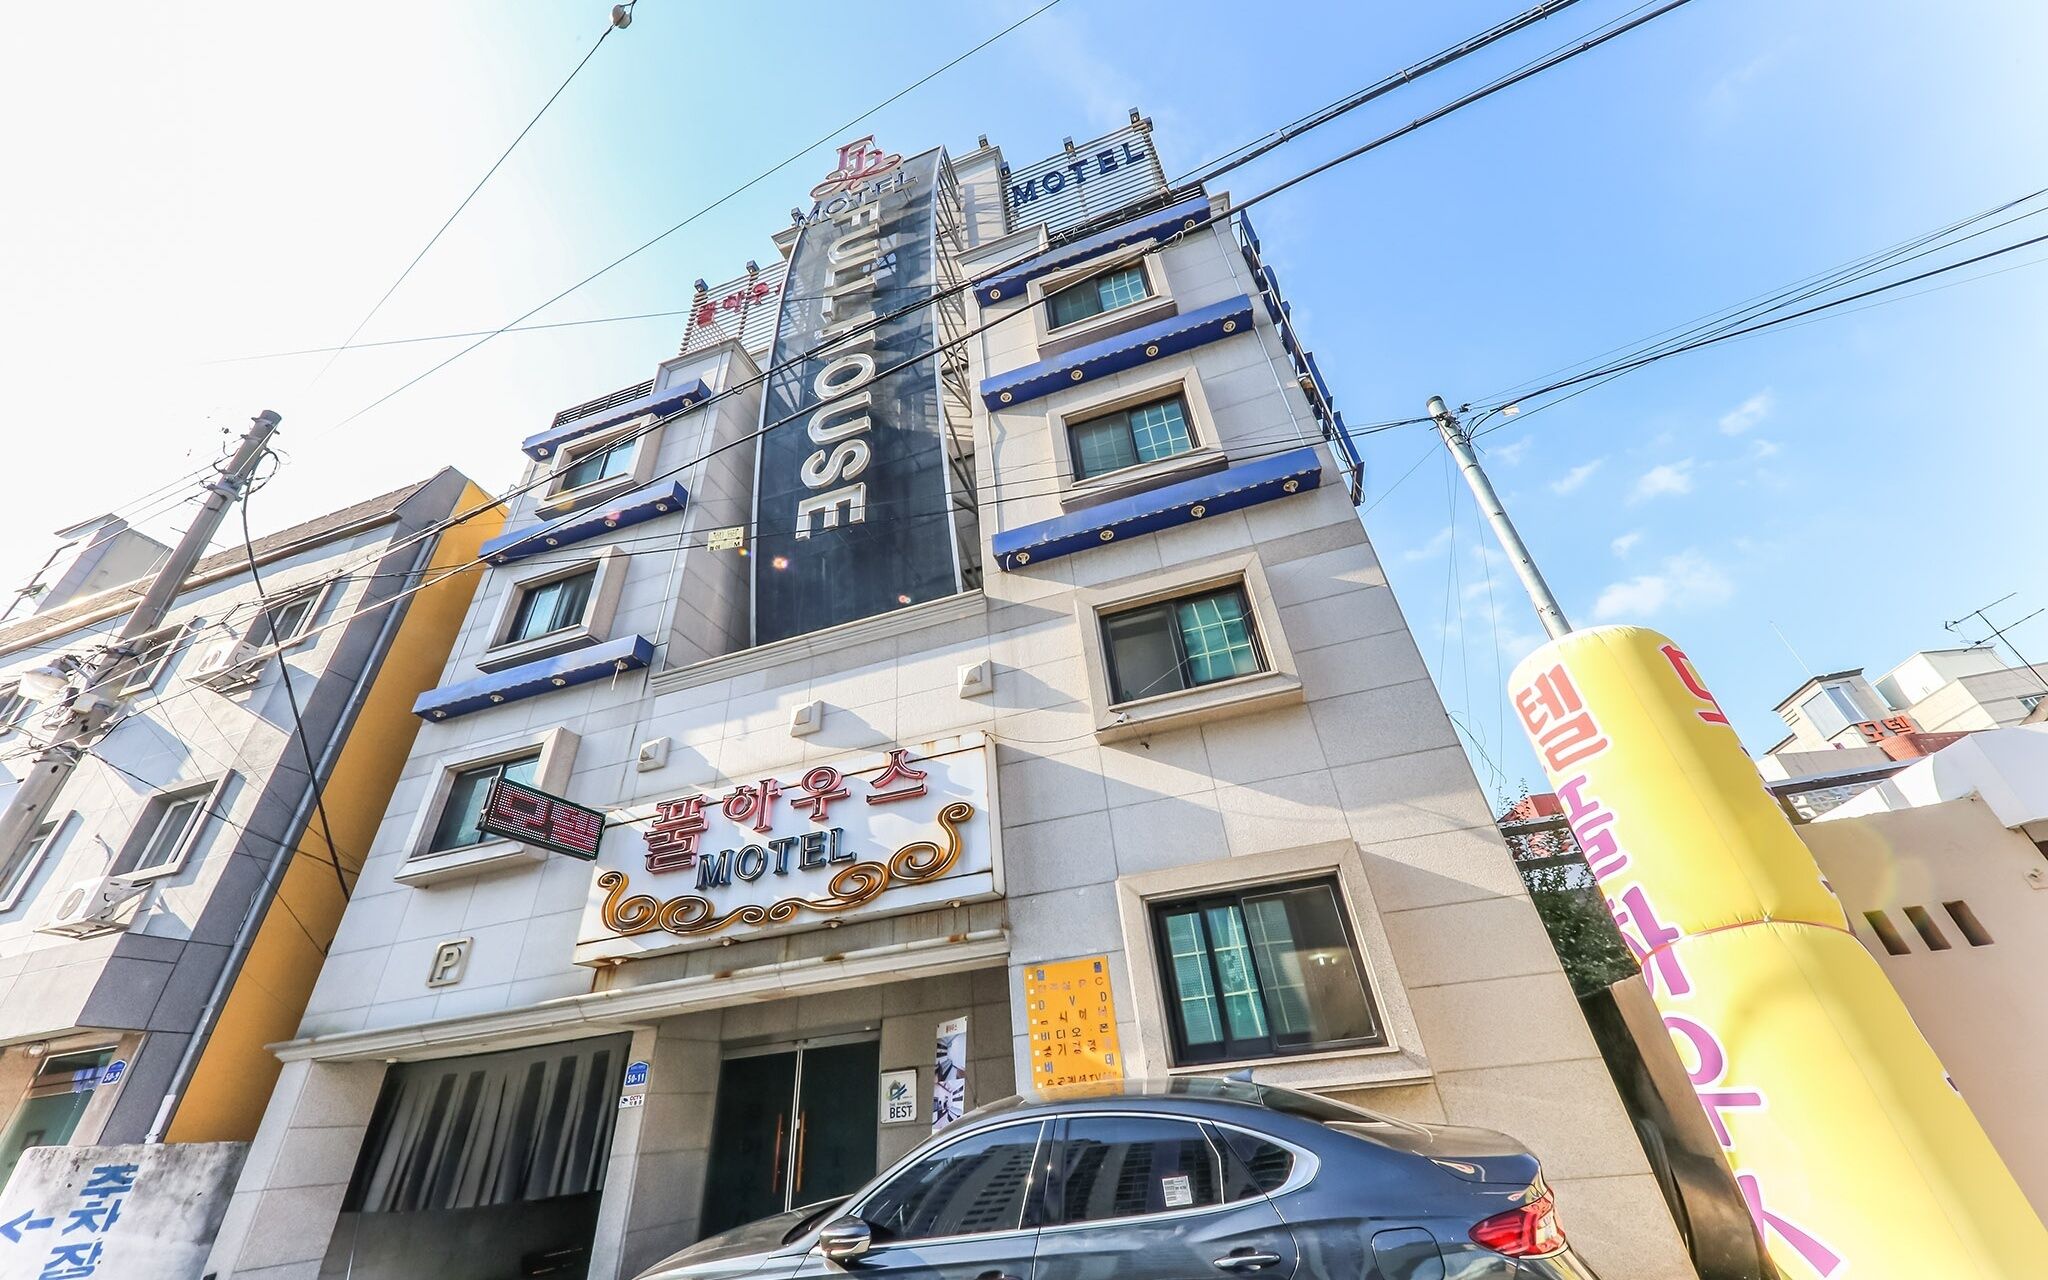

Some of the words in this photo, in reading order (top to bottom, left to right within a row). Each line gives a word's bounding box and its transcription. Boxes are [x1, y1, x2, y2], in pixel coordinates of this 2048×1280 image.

[793, 166, 919, 230] MOTEL
[1010, 142, 1146, 208] MOTEL
[697, 281, 783, 328] 풀하우
[1857, 714, 1916, 744] 모텔
[496, 787, 600, 852] 모텔
[644, 749, 929, 875] 풀하우스
[694, 826, 858, 892] MOTEL
[431, 945, 462, 981] P
[627, 1072, 645, 1084] 50-11
[889, 1105, 913, 1119] BEST
[38, 1162, 140, 1280] 주차장
